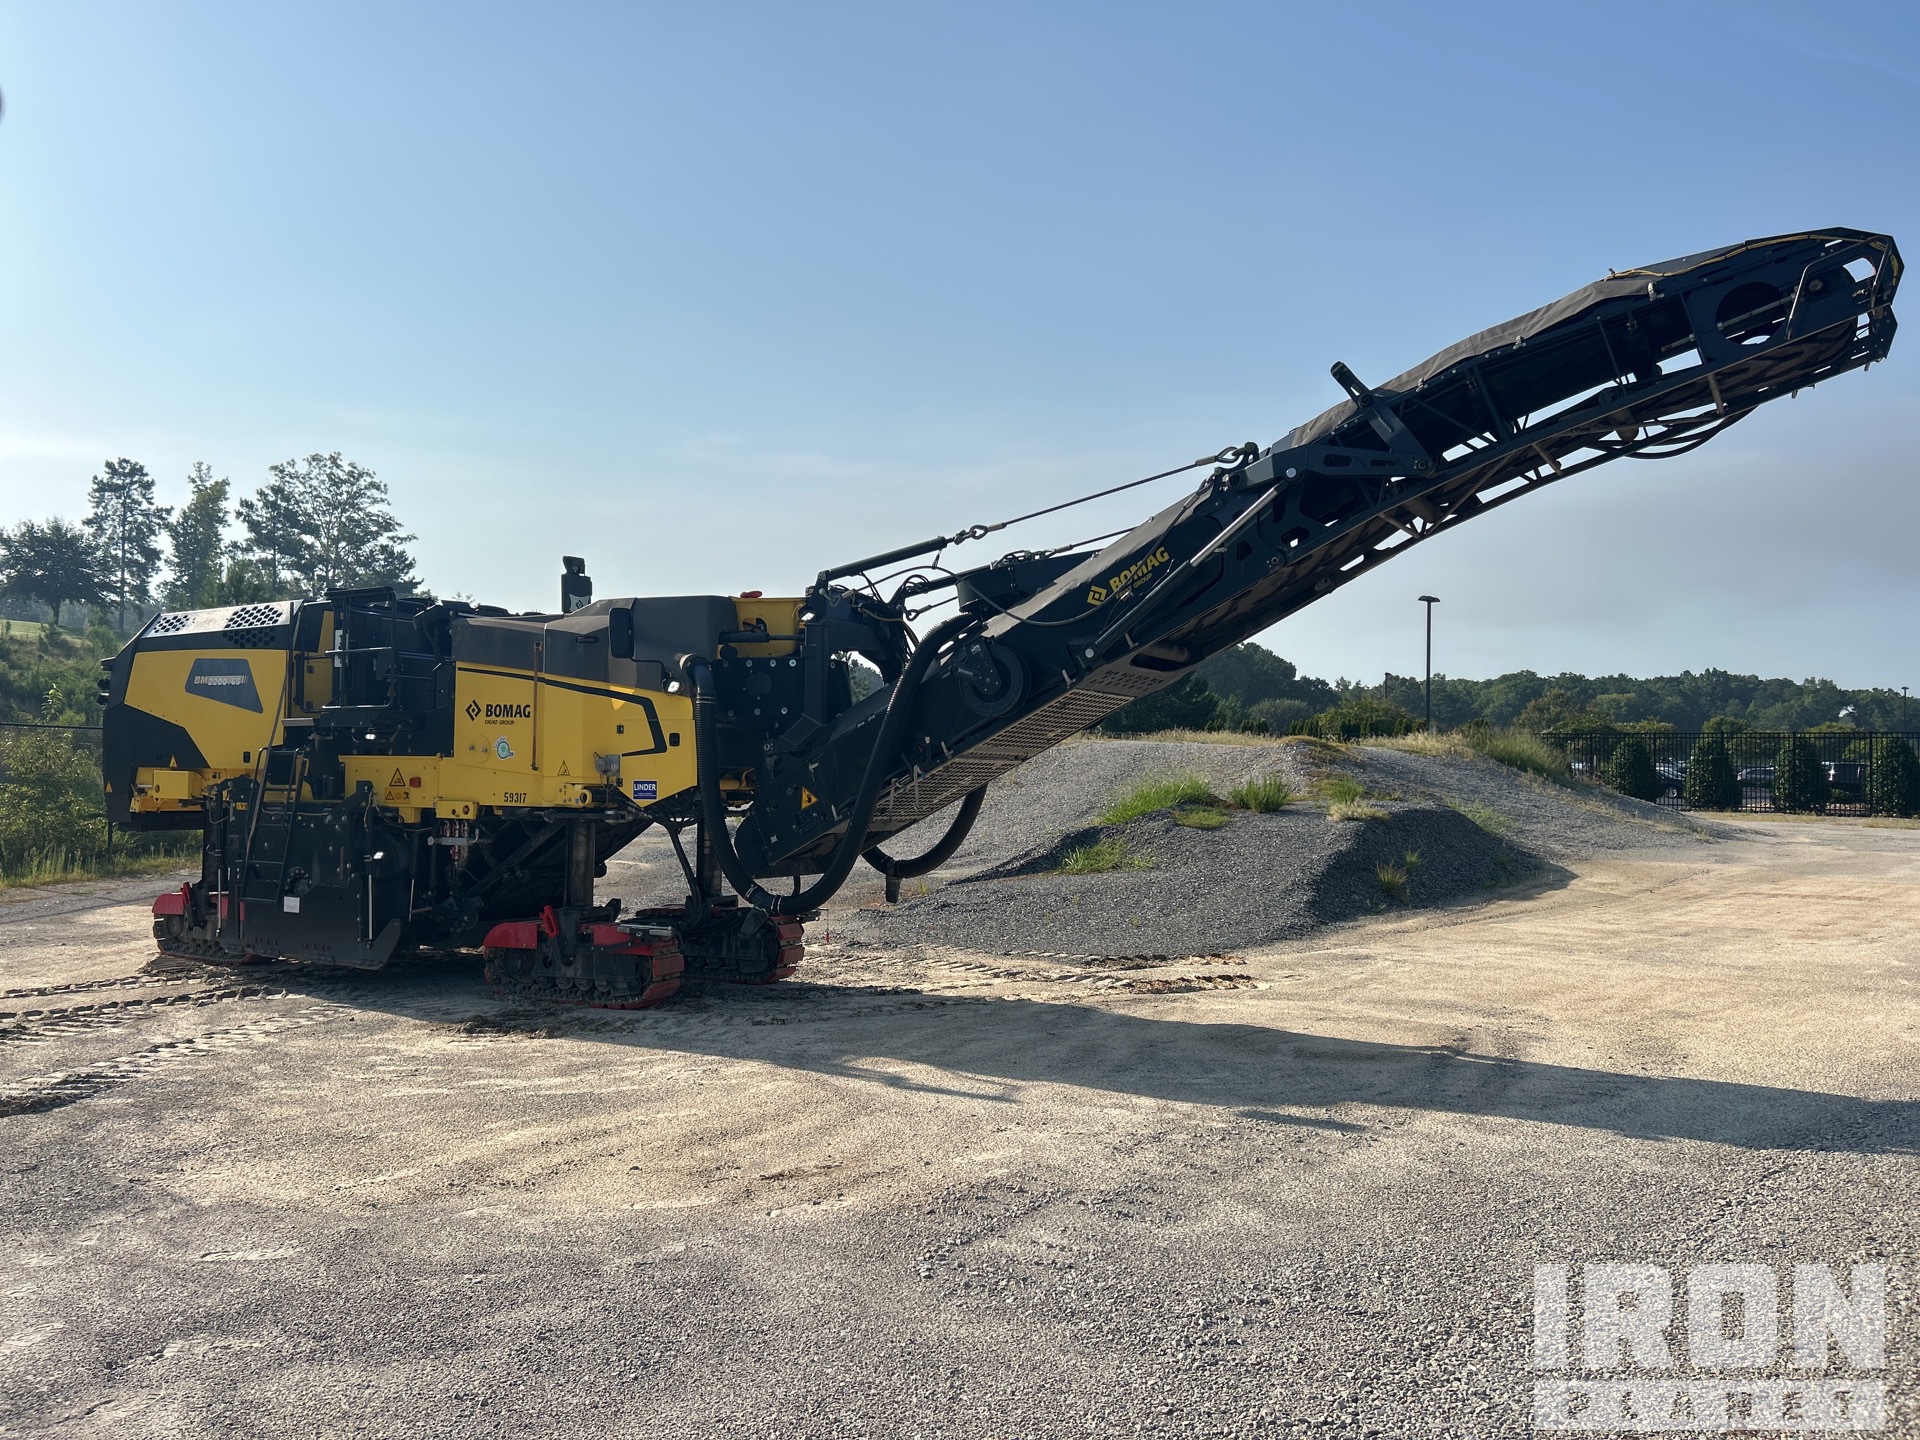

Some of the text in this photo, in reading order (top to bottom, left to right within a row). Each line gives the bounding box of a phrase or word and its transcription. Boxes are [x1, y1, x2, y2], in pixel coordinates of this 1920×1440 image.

[1109, 546, 1170, 593] BOMAG
[1133, 572, 1153, 588] GROUP
[485, 703, 531, 719] BOMAG
[633, 783, 657, 791] LINDER
[503, 792, 527, 804] 59317
